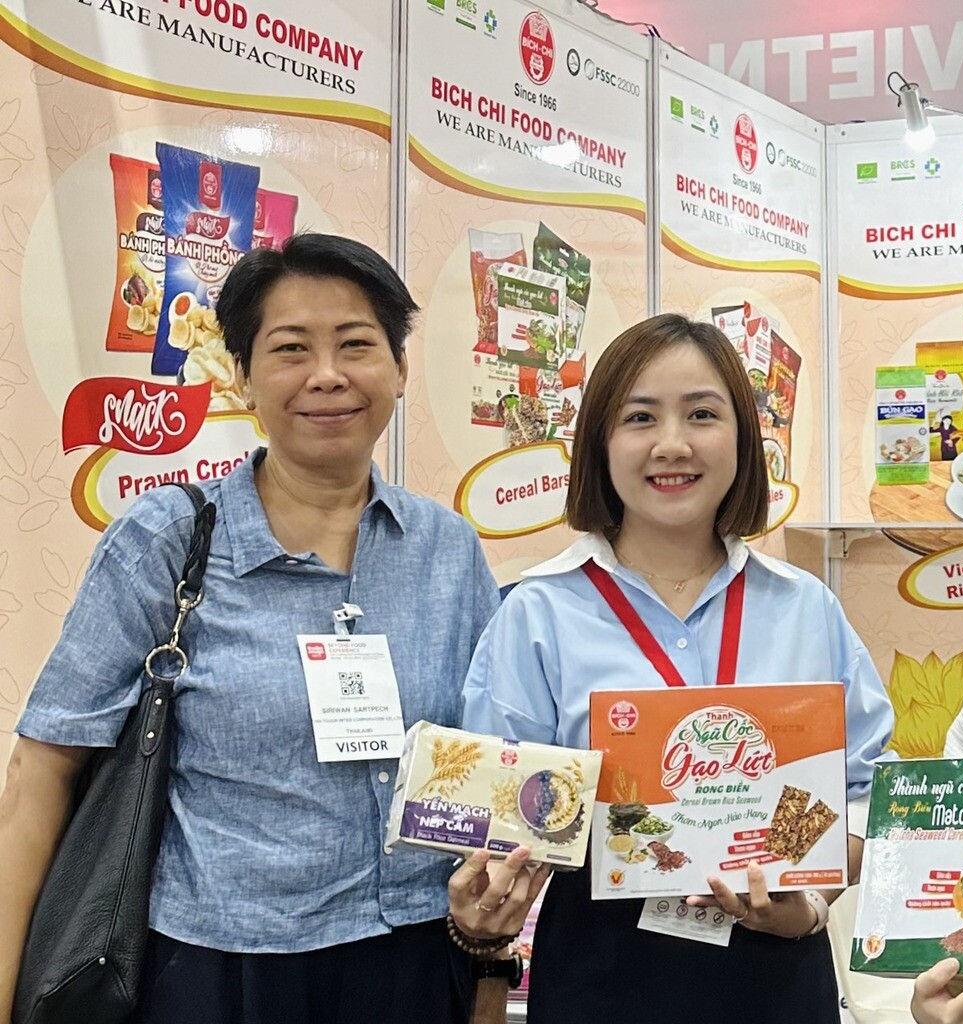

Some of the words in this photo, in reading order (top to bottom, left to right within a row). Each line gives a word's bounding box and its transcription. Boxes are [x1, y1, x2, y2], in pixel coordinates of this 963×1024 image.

[157, 13, 356, 95] MANUFACTURERS
[256, 13, 363, 71] COMPANY
[595, 66, 617, 87] FSSC
[617, 77, 641, 97] 22000
[431, 77, 472, 112] BICH
[478, 96, 506, 125] CHI
[511, 109, 552, 141] FOOD
[514, 82, 537, 104] Since
[539, 92, 558, 112] 1966
[436, 109, 462, 131] WE
[465, 120, 495, 144] ARE
[733, 173, 749, 190] Since
[676, 173, 706, 200] BICH
[709, 187, 729, 209] CHI
[732, 195, 760, 220] FOOD
[763, 207, 810, 239] COMPANY
[681, 200, 699, 217] WE
[701, 208, 723, 225] ARE
[866, 226, 914, 243] BICH
[921, 222, 955, 239] CHI
[167, 236, 202, 259] BÁNH
[872, 248, 901, 260] WE
[906, 245, 943, 258] ARE
[495, 478, 538, 505] Cereal
[706, 712, 734, 721] Thanh
[336, 740, 388, 753] VISITOR
[663, 742, 720, 788] Gạo
[695, 785, 725, 794] RONG
[915, 829, 947, 841] Seaweed
